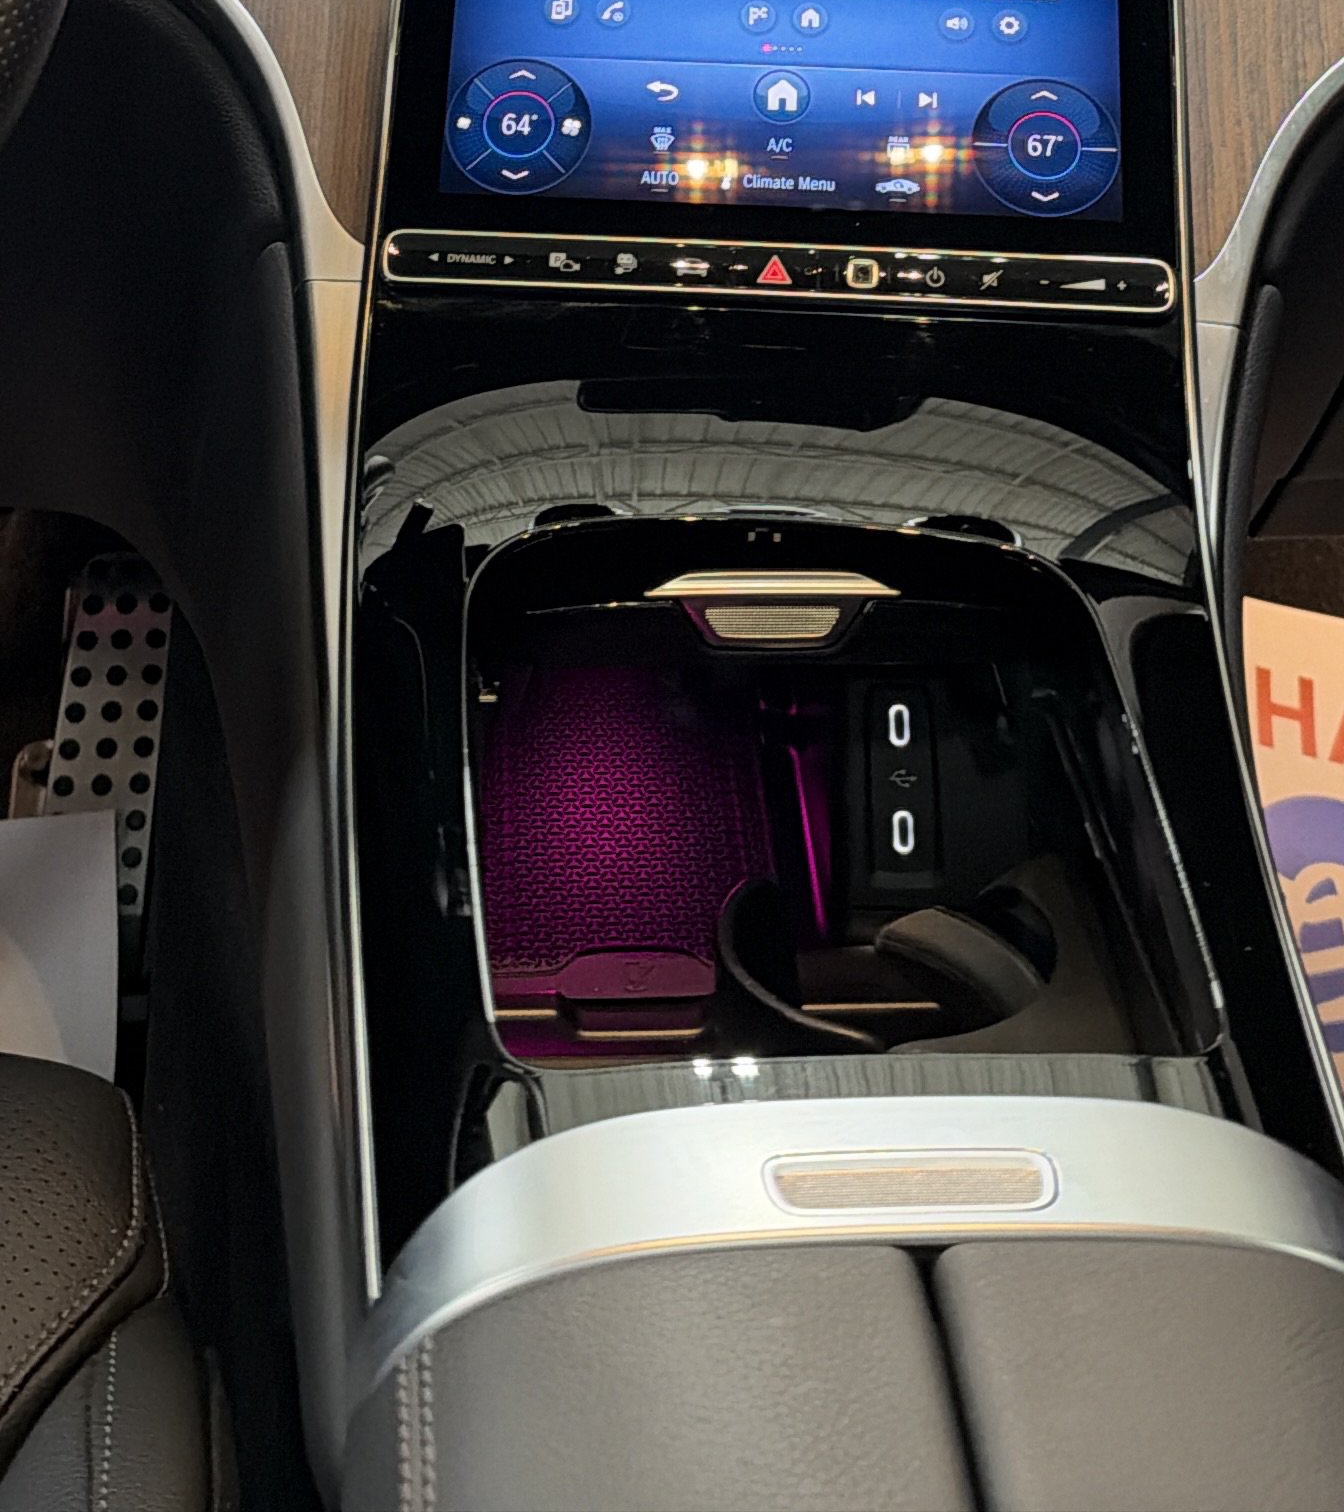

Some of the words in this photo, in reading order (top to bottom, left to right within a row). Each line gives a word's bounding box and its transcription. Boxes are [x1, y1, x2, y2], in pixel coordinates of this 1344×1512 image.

[501, 113, 540, 136] 64°
[766, 138, 793, 153] A/C
[1026, 134, 1065, 157] 67°
[641, 170, 680, 186] AUTO
[742, 174, 796, 190] Climate
[799, 176, 836, 192] Menu
[446, 253, 497, 265] DYNAMIC
